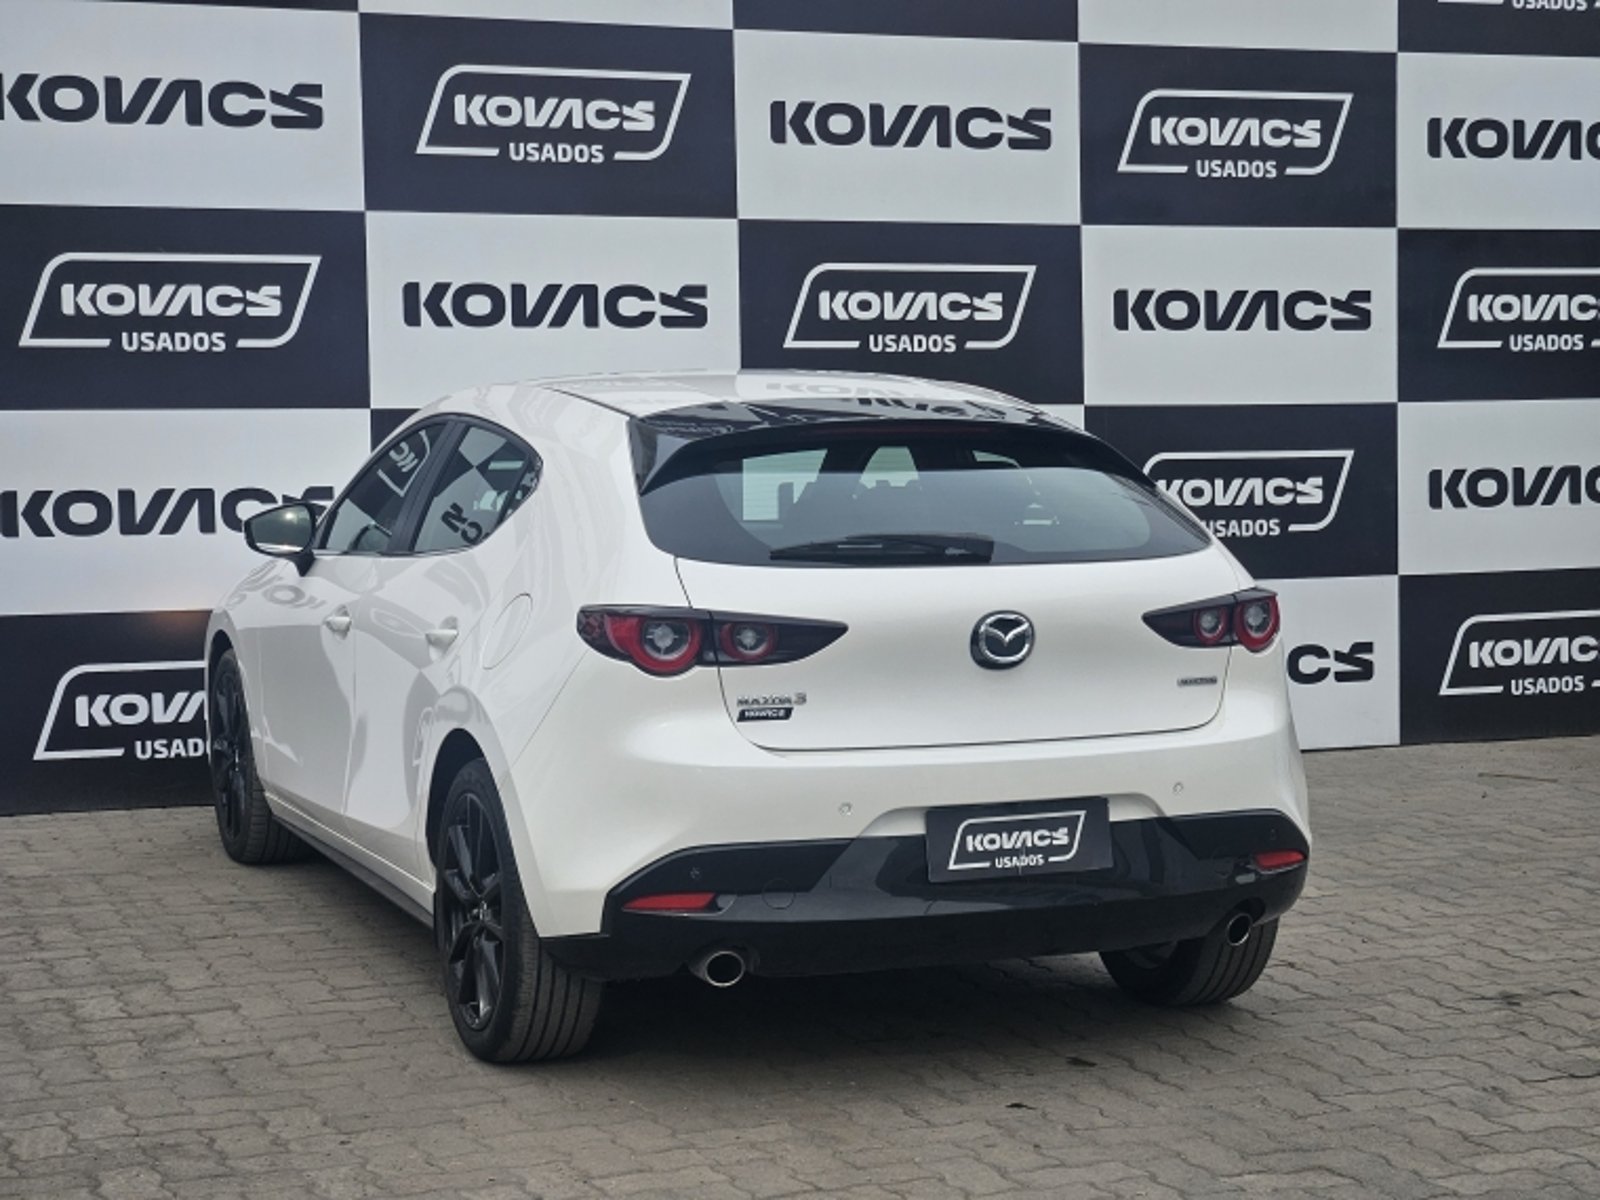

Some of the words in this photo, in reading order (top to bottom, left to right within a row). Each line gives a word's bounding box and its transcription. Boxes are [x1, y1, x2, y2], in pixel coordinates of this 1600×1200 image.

[0, 72, 324, 129] KOVACS
[453, 94, 656, 132] KOVACS
[769, 100, 1052, 151] KOVACS
[1150, 116, 1322, 148] KOVACS
[509, 142, 605, 164] USADOS
[1196, 159, 1277, 179] USADOS
[60, 283, 282, 317] KOVACS
[402, 281, 708, 328] KOVACS
[818, 290, 1004, 322] KOVACS
[1113, 288, 1372, 332] KOVACS
[1468, 294, 1600, 322] KOVAC
[121, 331, 226, 352] USADOS
[868, 334, 957, 353] USADOS
[1509, 334, 1584, 352] USADOS
[1469, 635, 1600, 668] KOVAC
[1510, 675, 1585, 696] USADOS
[965, 827, 1070, 852] KOVACS
[994, 853, 1045, 869] USADOS
